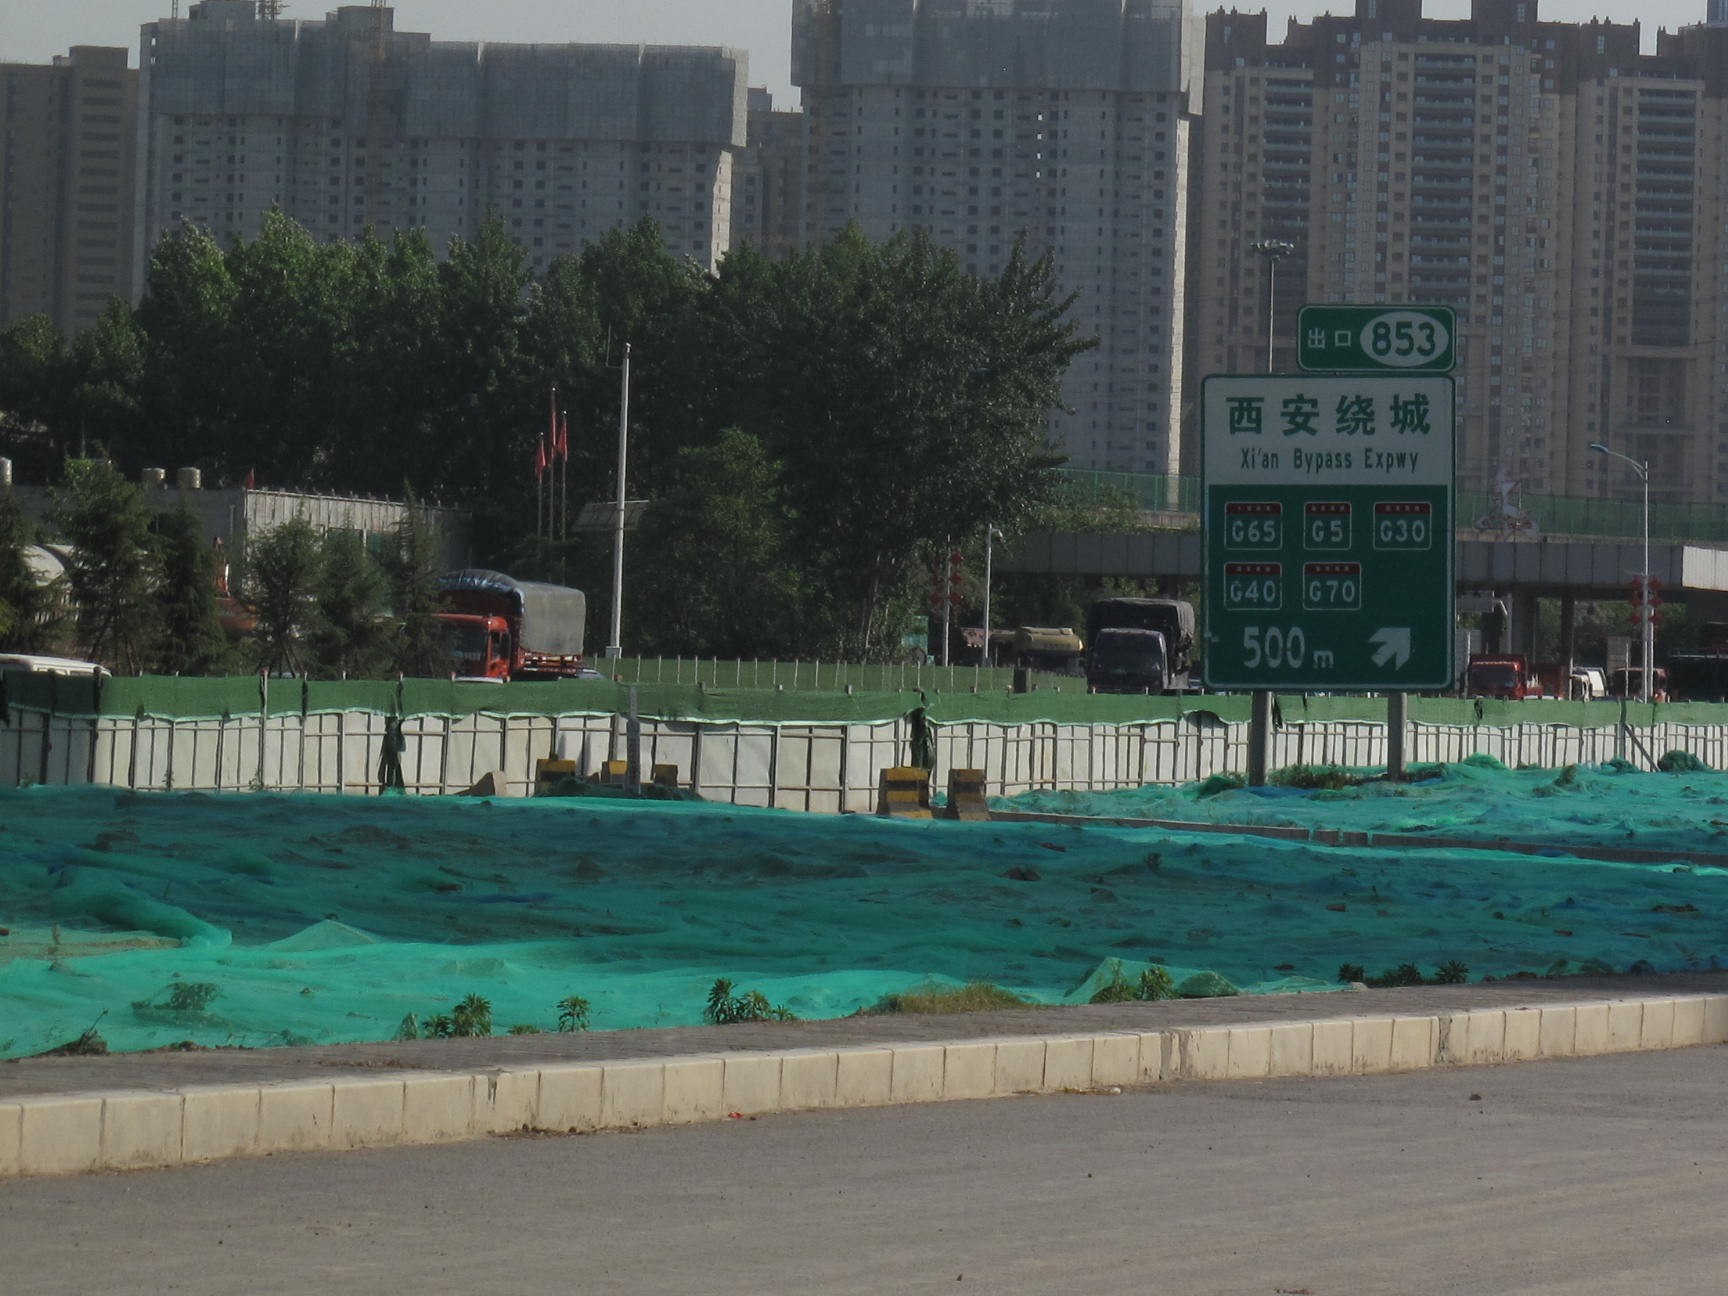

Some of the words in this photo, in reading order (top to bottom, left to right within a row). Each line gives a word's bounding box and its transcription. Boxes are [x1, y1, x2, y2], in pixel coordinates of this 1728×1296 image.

[1307, 327, 1352, 349] 出口
[1371, 320, 1437, 357] 853
[1225, 392, 1432, 436] 西安绕城
[1240, 447, 1280, 470] Xi'an
[1293, 447, 1353, 473] Bypass
[1364, 447, 1419, 474] Expwy
[1231, 519, 1276, 543] G65
[1311, 519, 1344, 543] G5
[1379, 519, 1425, 543] G30
[1229, 579, 1276, 603] G40
[1309, 579, 1356, 603] G70
